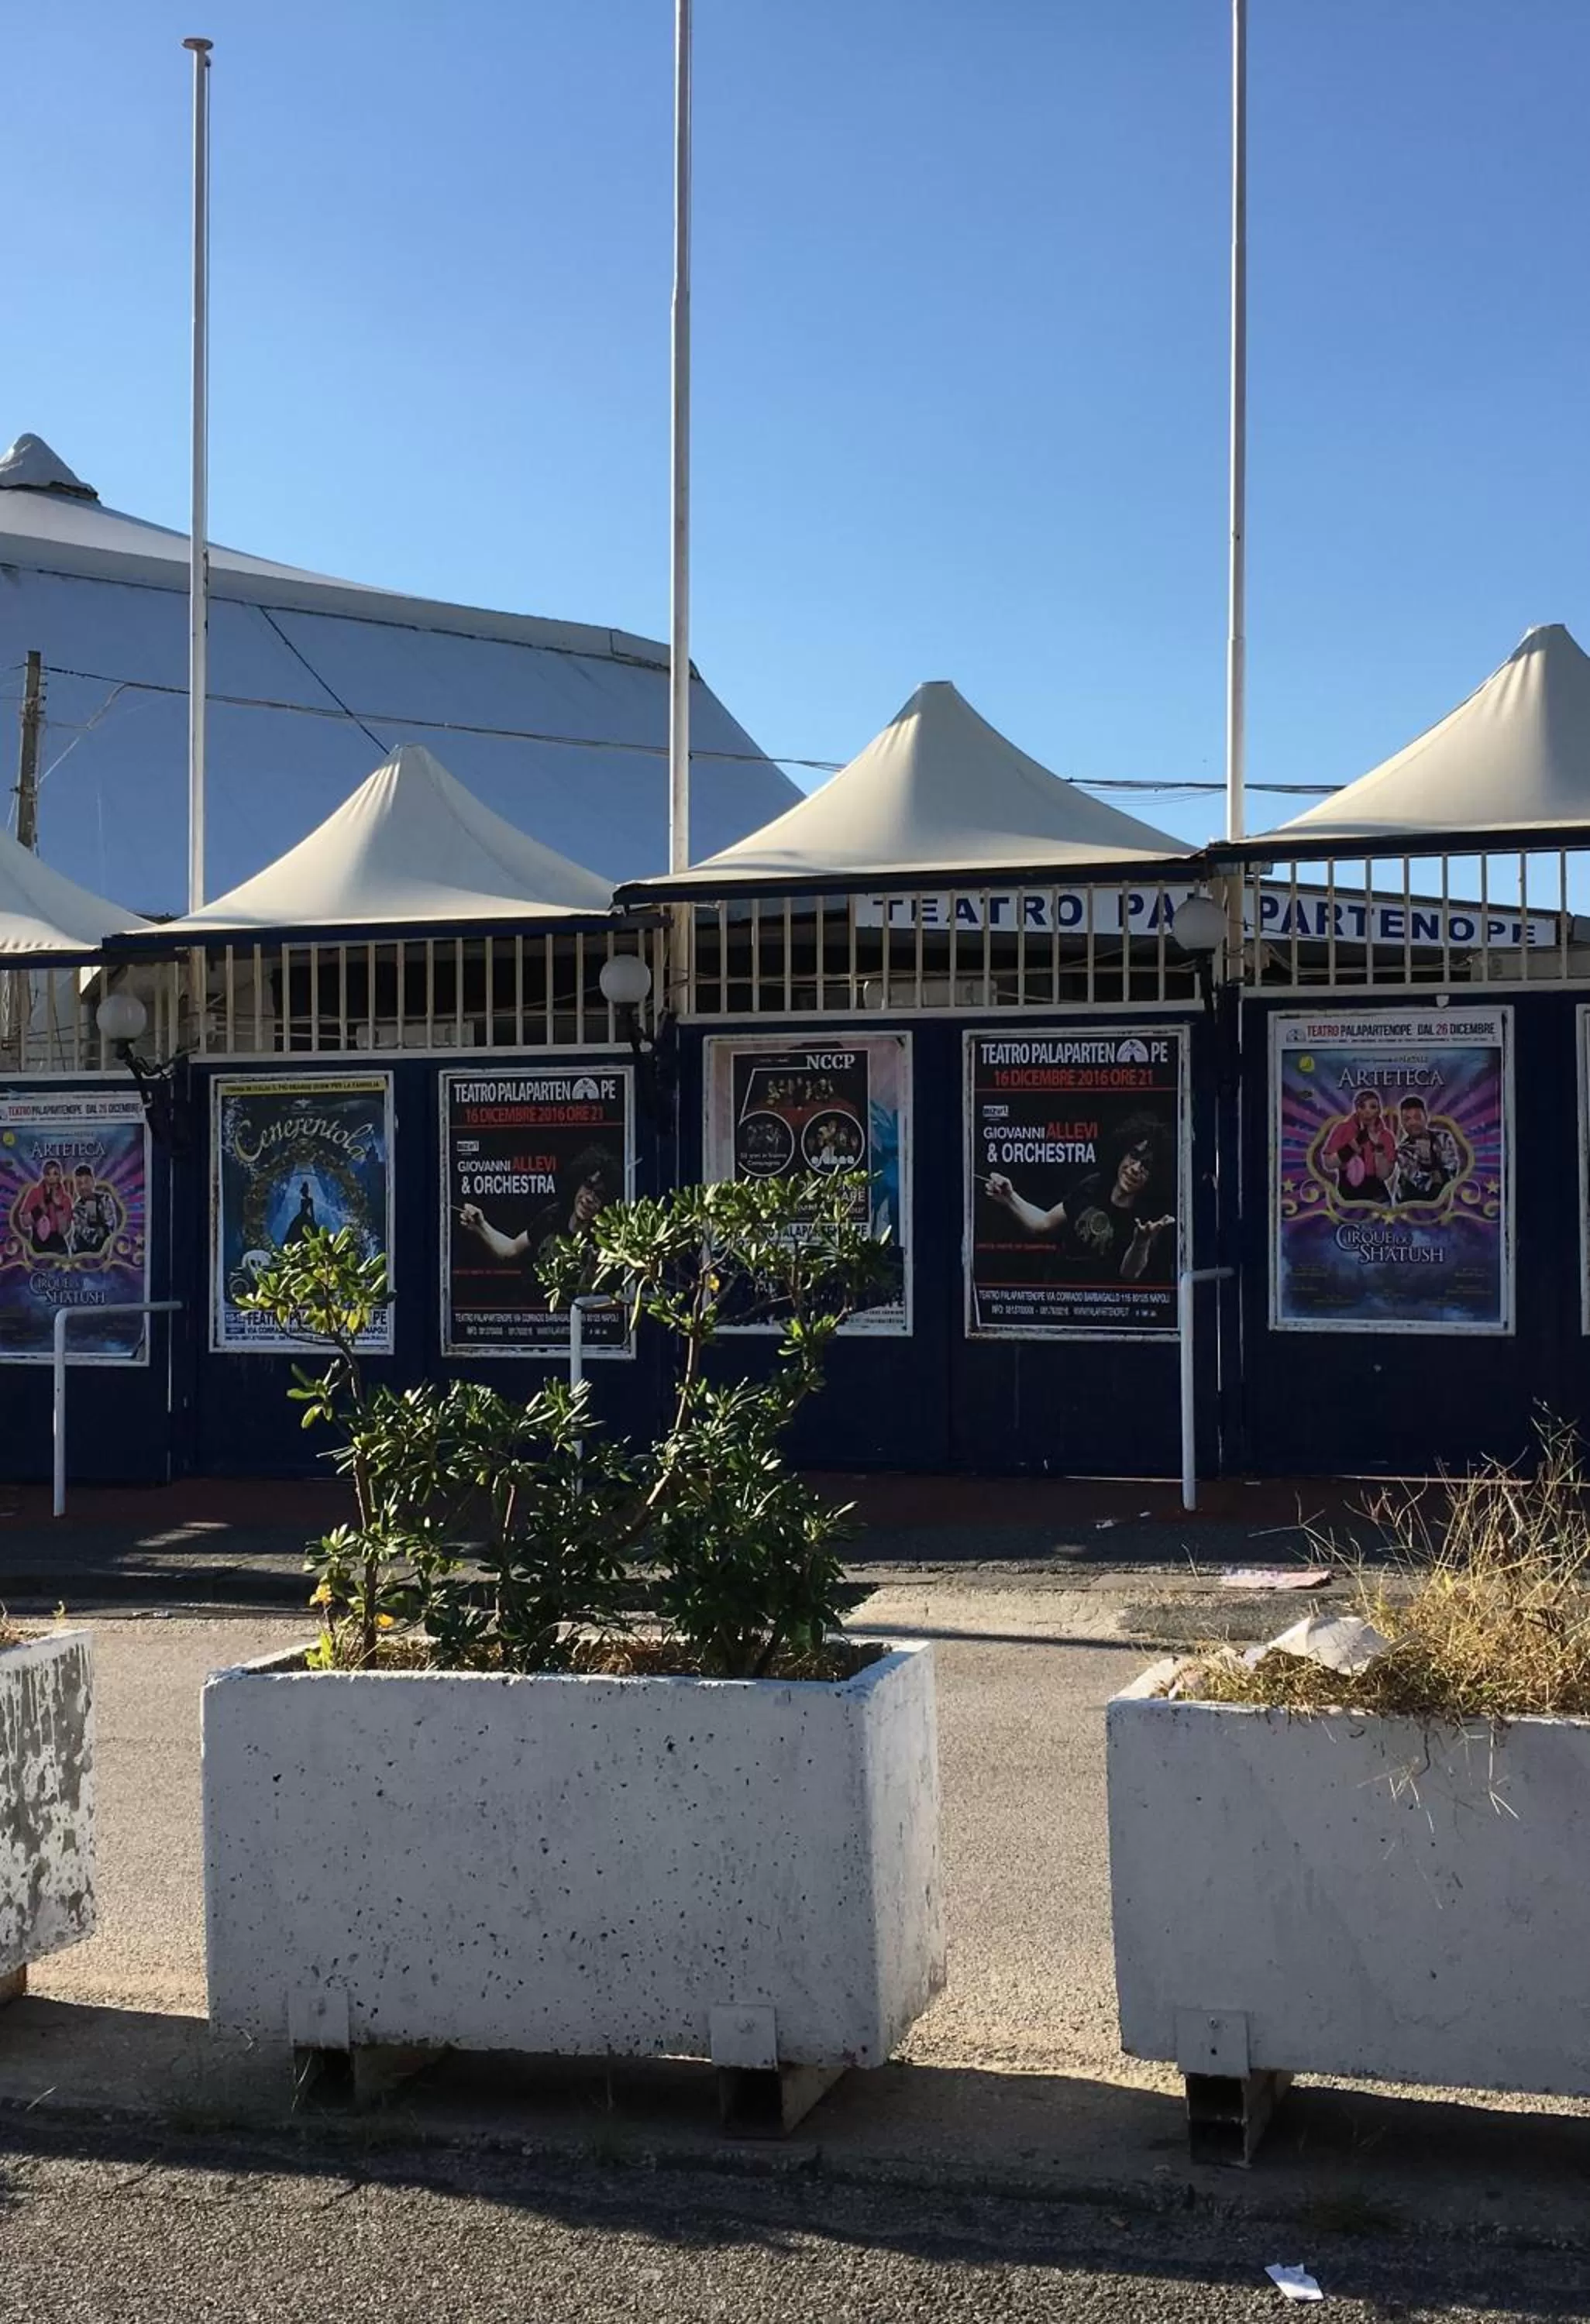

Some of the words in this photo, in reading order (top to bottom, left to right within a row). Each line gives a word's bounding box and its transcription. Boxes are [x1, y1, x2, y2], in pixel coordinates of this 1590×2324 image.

[872, 894, 1085, 927] TEATRO
[1118, 892, 1536, 944] PAPARTENOPE
[1306, 1025, 1340, 1037] TEATRO
[1340, 1024, 1412, 1037] PALAPARTENOPE
[1417, 1023, 1434, 1035] DAL
[1436, 1023, 1448, 1034] 26
[1450, 1022, 1495, 1034] DICEMBRE
[806, 1054, 855, 1070] NCCP
[981, 1043, 1030, 1064] TEATRO
[995, 1071, 1007, 1085] 16
[1010, 1070, 1074, 1085] DICEMBRE
[1078, 1070, 1108, 1085] 2016
[1110, 1069, 1136, 1085] ORE
[1139, 1069, 1153, 1084] 21
[1338, 1067, 1445, 1086] ARTETECA
[454, 1082, 497, 1103] TEATRO
[466, 1108, 478, 1123] 16
[480, 1106, 538, 1123] DICEMBRE
[539, 1106, 566, 1122] 2016
[566, 1105, 590, 1122] ORE
[591, 1105, 604, 1120] 21
[234, 1117, 373, 1162] Cenerentola
[983, 1127, 1045, 1140] GIOVANNI
[1047, 1122, 1098, 1139] ALLEVI
[986, 1144, 998, 1163] &
[1001, 1143, 1096, 1164] ORCHESTRA
[457, 1160, 511, 1173] GIOVANNI
[512, 1156, 557, 1172] ALLEVI
[461, 1175, 471, 1194] &
[473, 1174, 556, 1194] ORCHESTRA
[1359, 1243, 1445, 1263] SHATUSH
